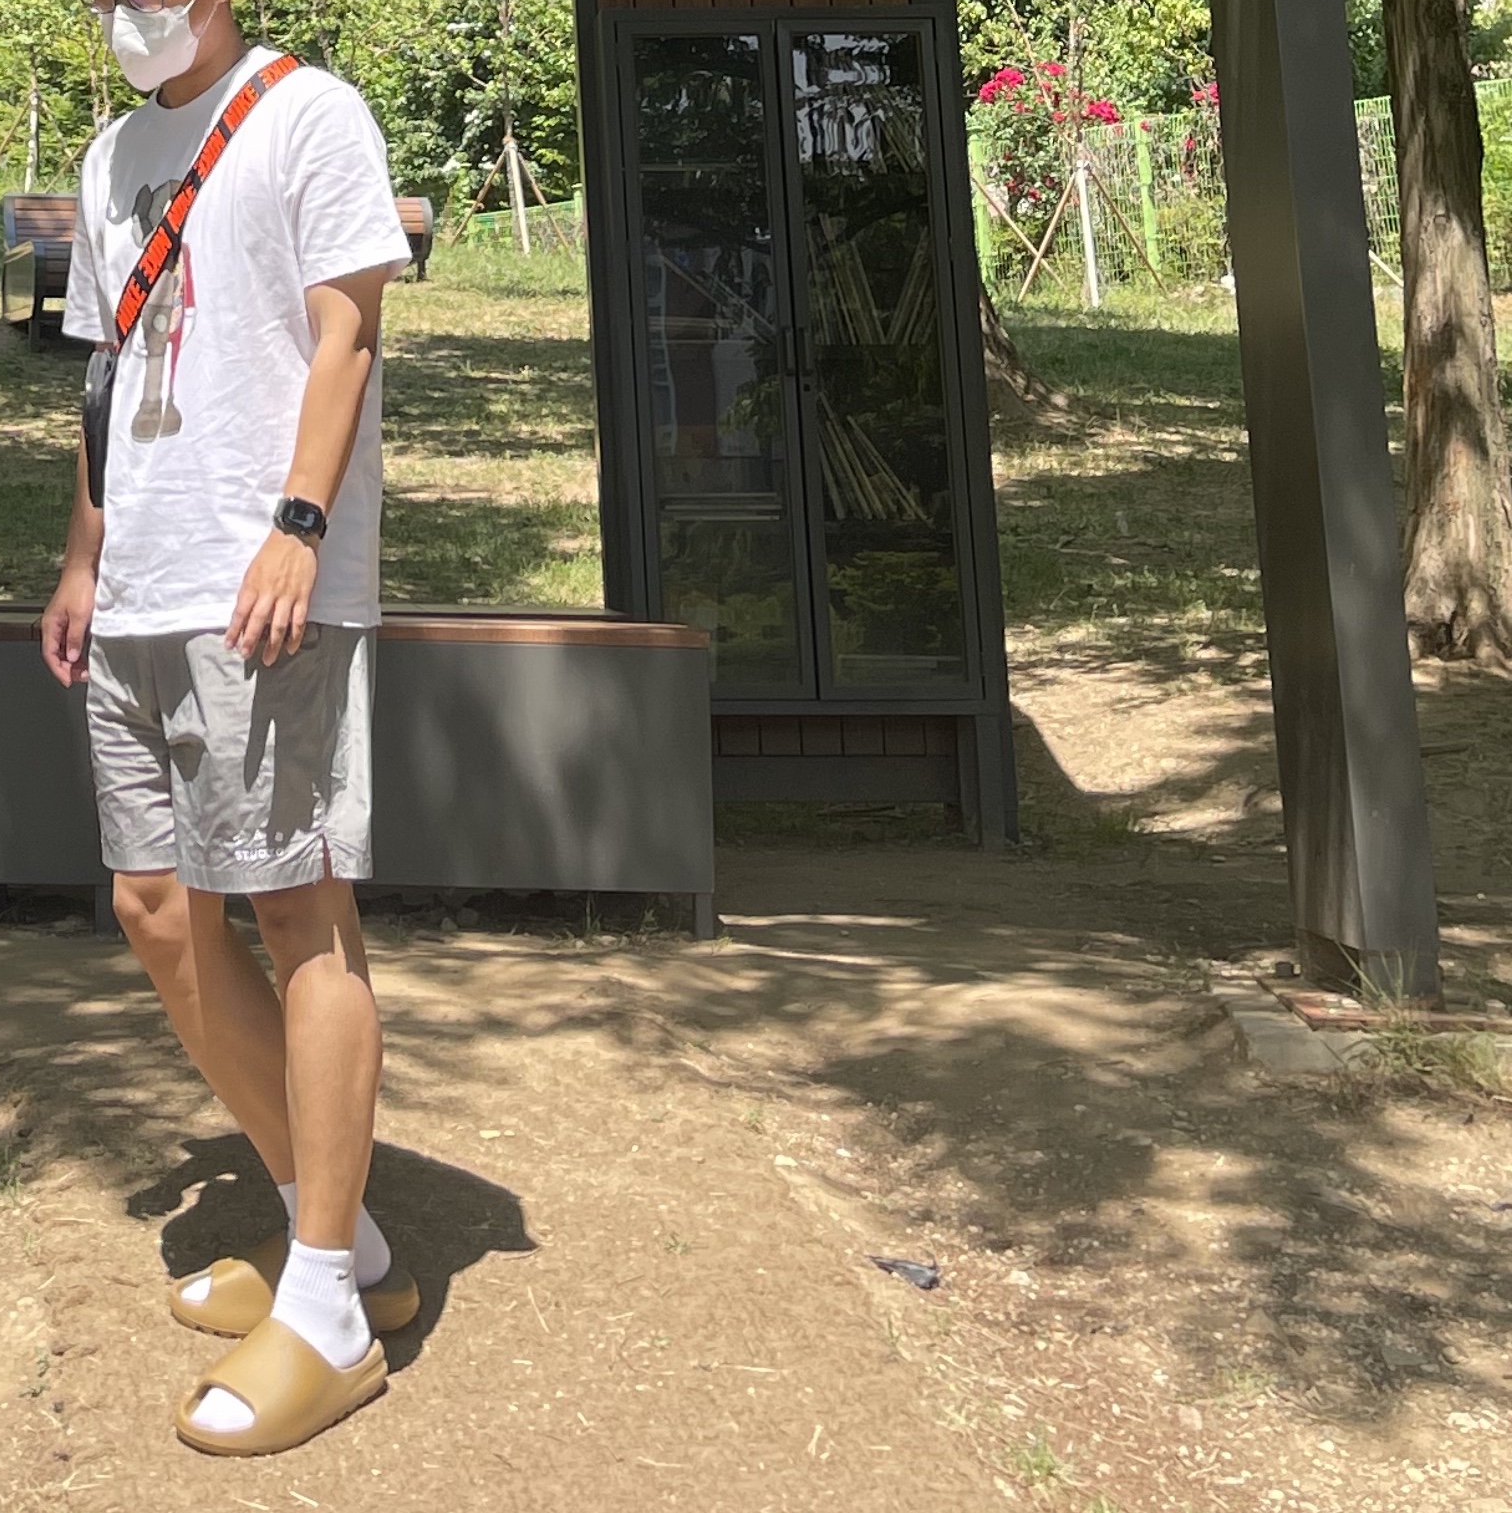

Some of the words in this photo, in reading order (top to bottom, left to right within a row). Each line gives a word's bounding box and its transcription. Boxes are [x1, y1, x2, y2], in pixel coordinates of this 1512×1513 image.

[223, 81, 260, 133] NIKE
[193, 127, 226, 182] NIKE
[138, 226, 173, 285] NIKE
[116, 274, 148, 336] NIKE
